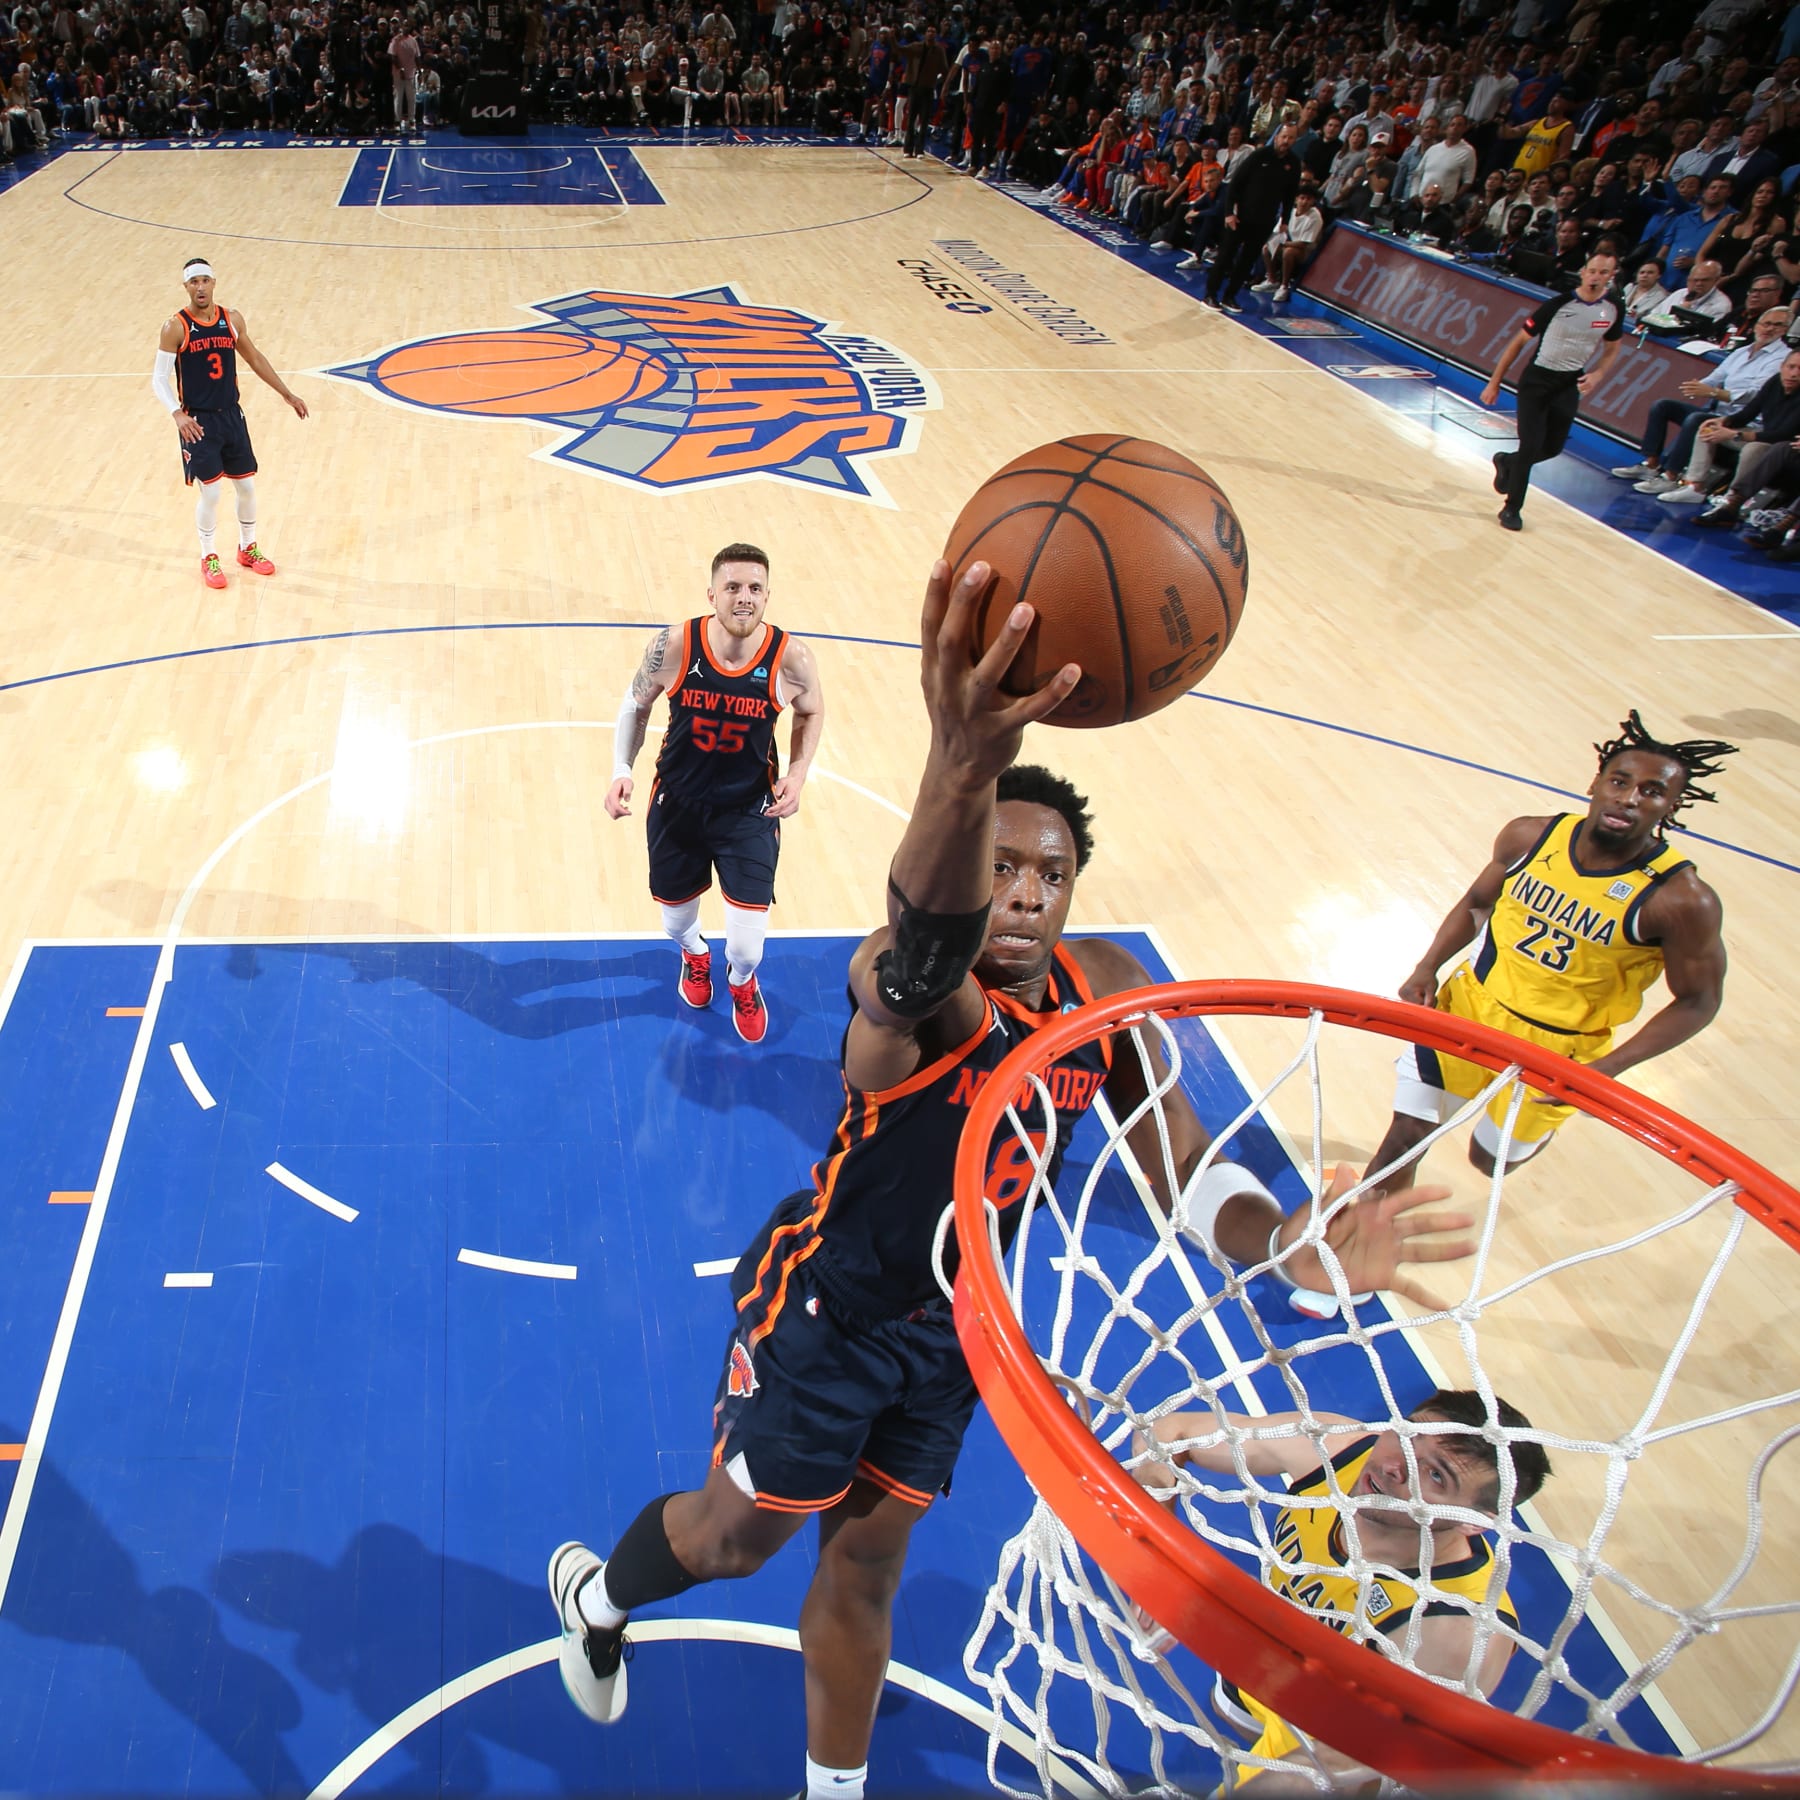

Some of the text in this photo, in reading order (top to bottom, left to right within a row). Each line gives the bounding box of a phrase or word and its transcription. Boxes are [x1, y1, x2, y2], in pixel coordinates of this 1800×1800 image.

[73, 139, 427, 150] NEW YORK KNICKS
[897, 259, 974, 300] CHASE
[930, 239, 1117, 345] MADISON SQUARE GARDEN
[1333, 245, 1489, 345] Emirates
[189, 336, 234, 353] NEW YORK
[207, 352, 223, 380] 3
[818, 334, 927, 409] NEW YORK
[584, 290, 900, 484] KNICKS
[681, 688, 769, 719] NEW YORK
[691, 715, 750, 753] 55
[1510, 871, 1617, 946] INDIANA
[1515, 914, 1577, 972] 23
[983, 1130, 1047, 1210] 8
